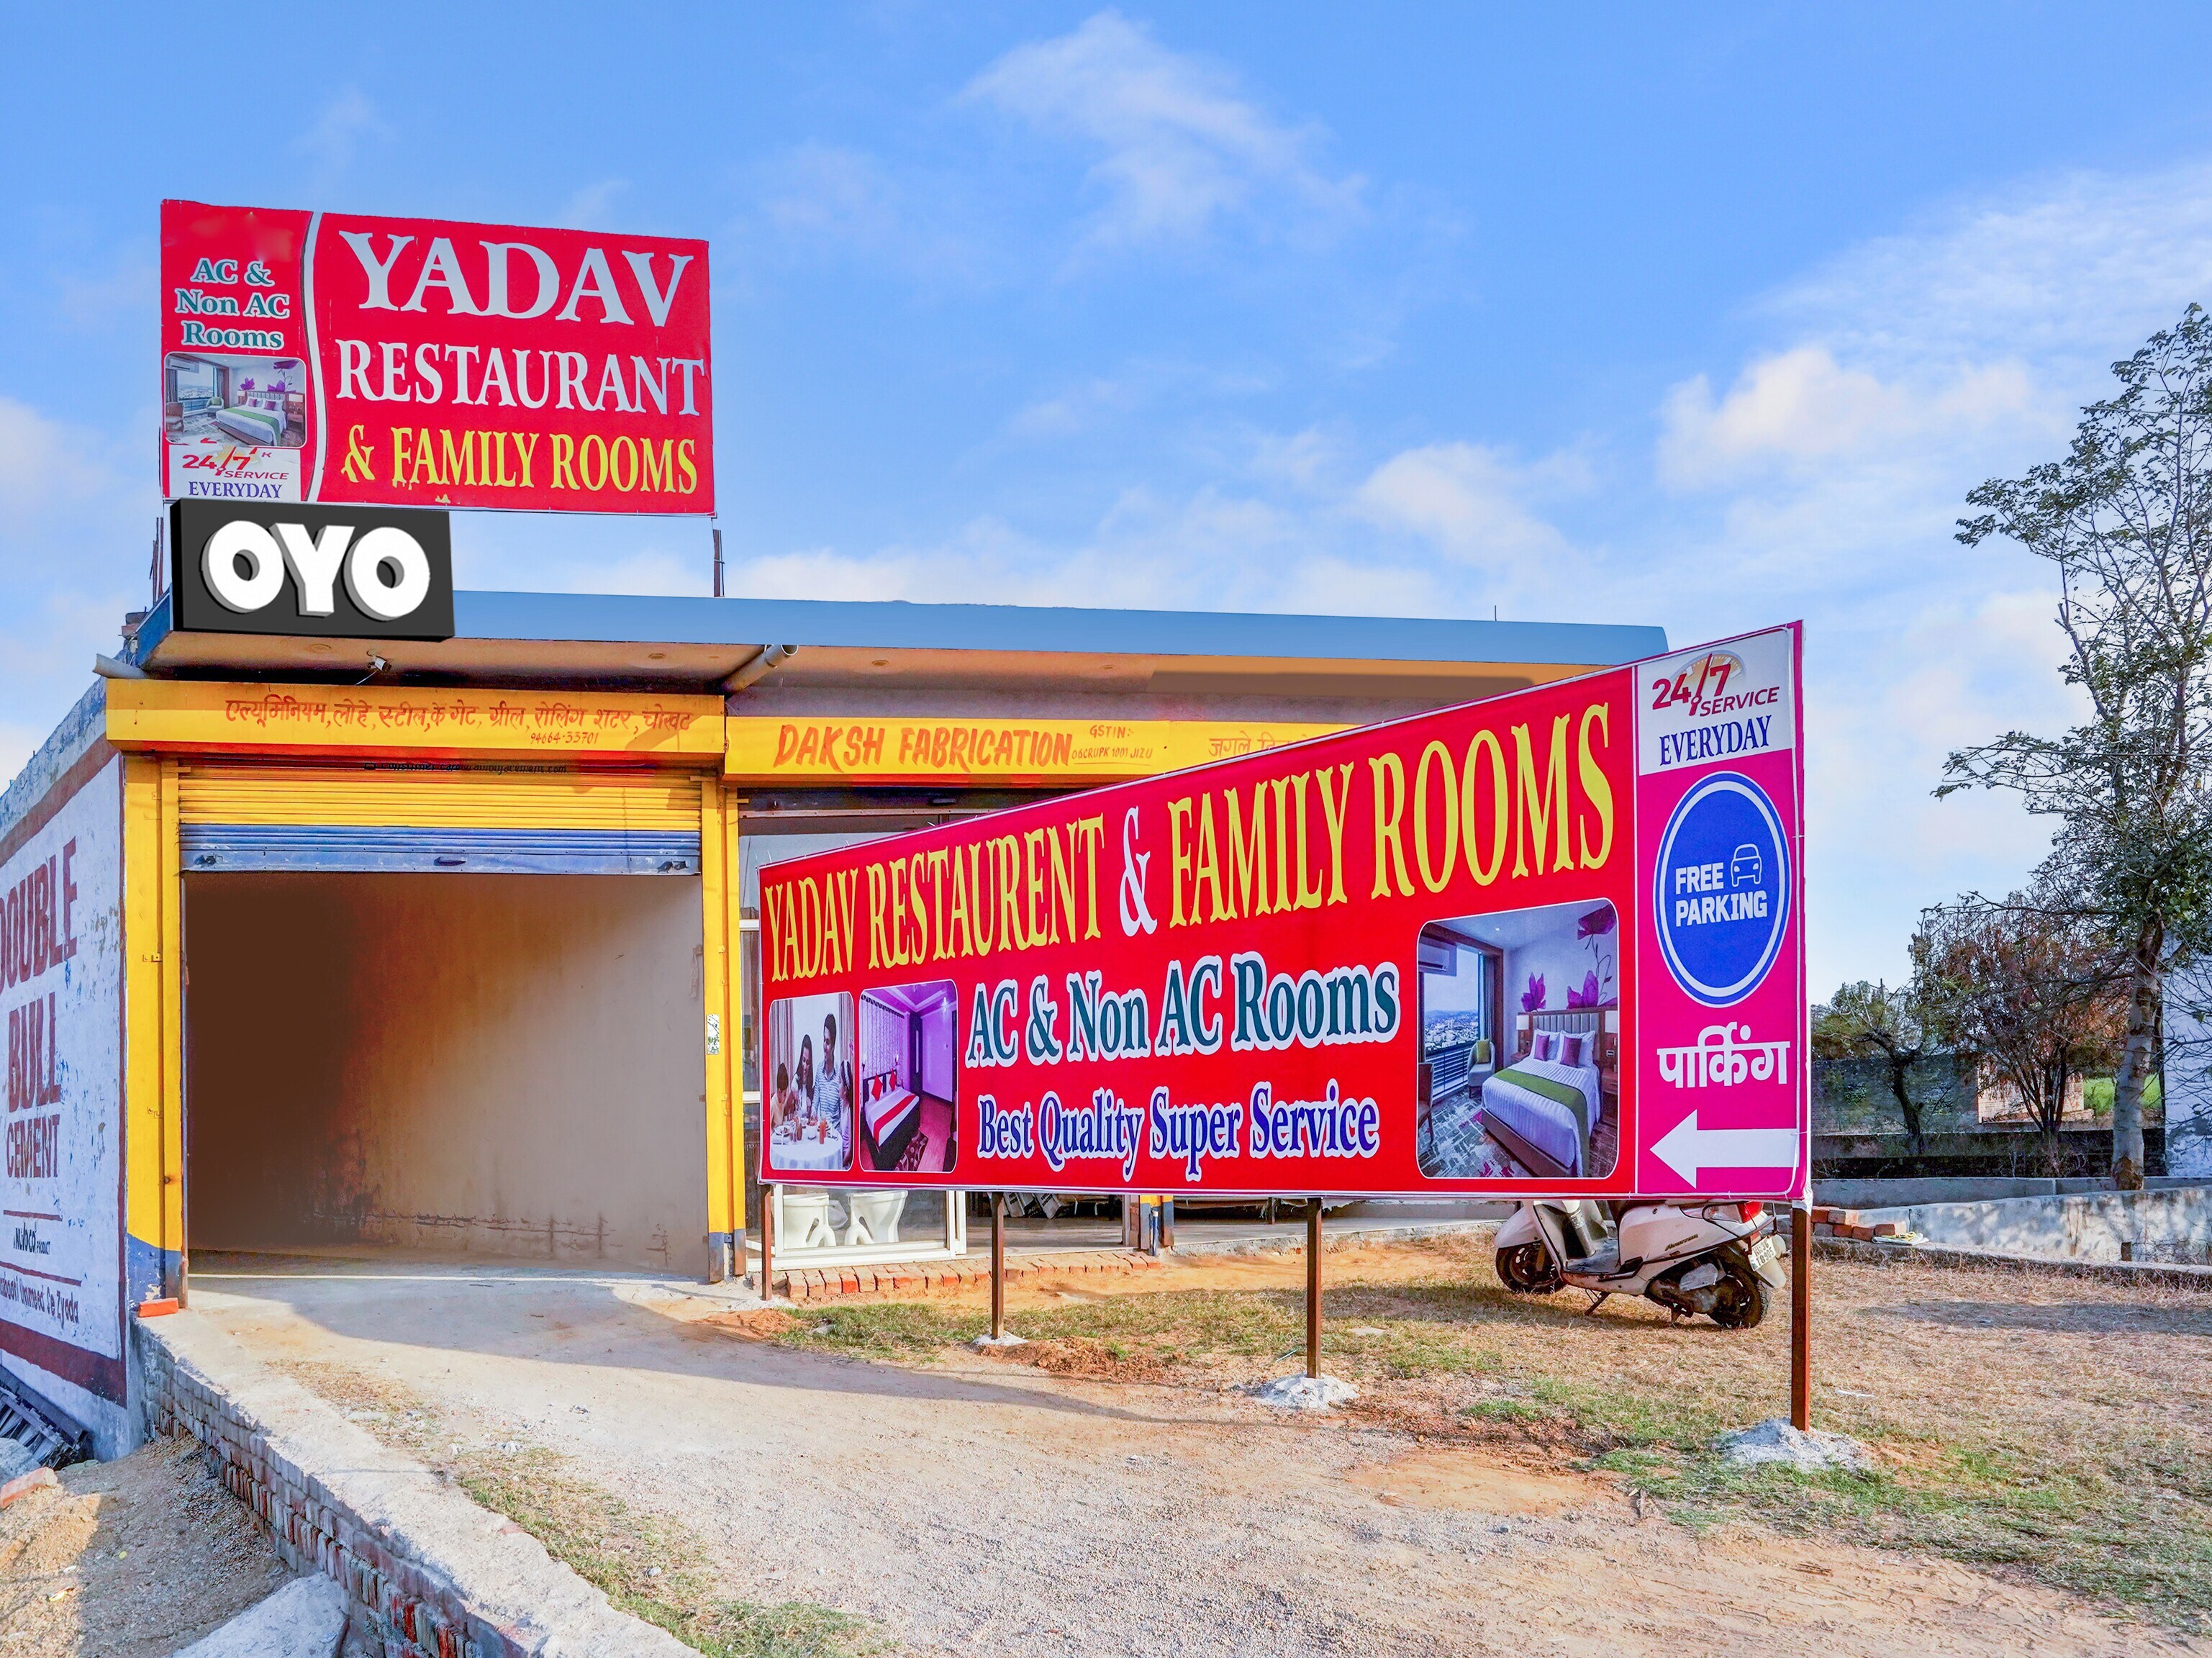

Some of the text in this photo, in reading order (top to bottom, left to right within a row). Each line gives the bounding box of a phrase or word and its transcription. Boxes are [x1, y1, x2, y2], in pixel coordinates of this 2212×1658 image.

[190, 258, 275, 286] AC &
[338, 230, 694, 327] YADAV
[175, 289, 290, 319] Non AC
[181, 320, 284, 350] Rooms
[335, 340, 705, 417] RESTAURANT
[224, 471, 289, 480] SERVICE
[340, 424, 697, 494] & FAMILY ROOMS
[189, 481, 283, 499] EVERYDAY
[201, 520, 430, 622] OYO
[1700, 686, 1780, 717] SERVICE
[772, 725, 1073, 773] DAKSH FABRICATION
[1659, 715, 1772, 766] EVERYDAY
[764, 702, 1615, 982] YADAV RESTAURENT & FAMILY ROOMS
[1675, 862, 1724, 894] FREE
[1675, 889, 1767, 928] PARKING
[965, 951, 1401, 1069] AC & Non AC Rooms
[9, 992, 61, 1113] BULL
[1656, 1021, 1791, 1089] पार्किंग
[6, 1114, 60, 1178] CEMENT
[977, 1078, 1380, 1182] Best Quality Super Service
